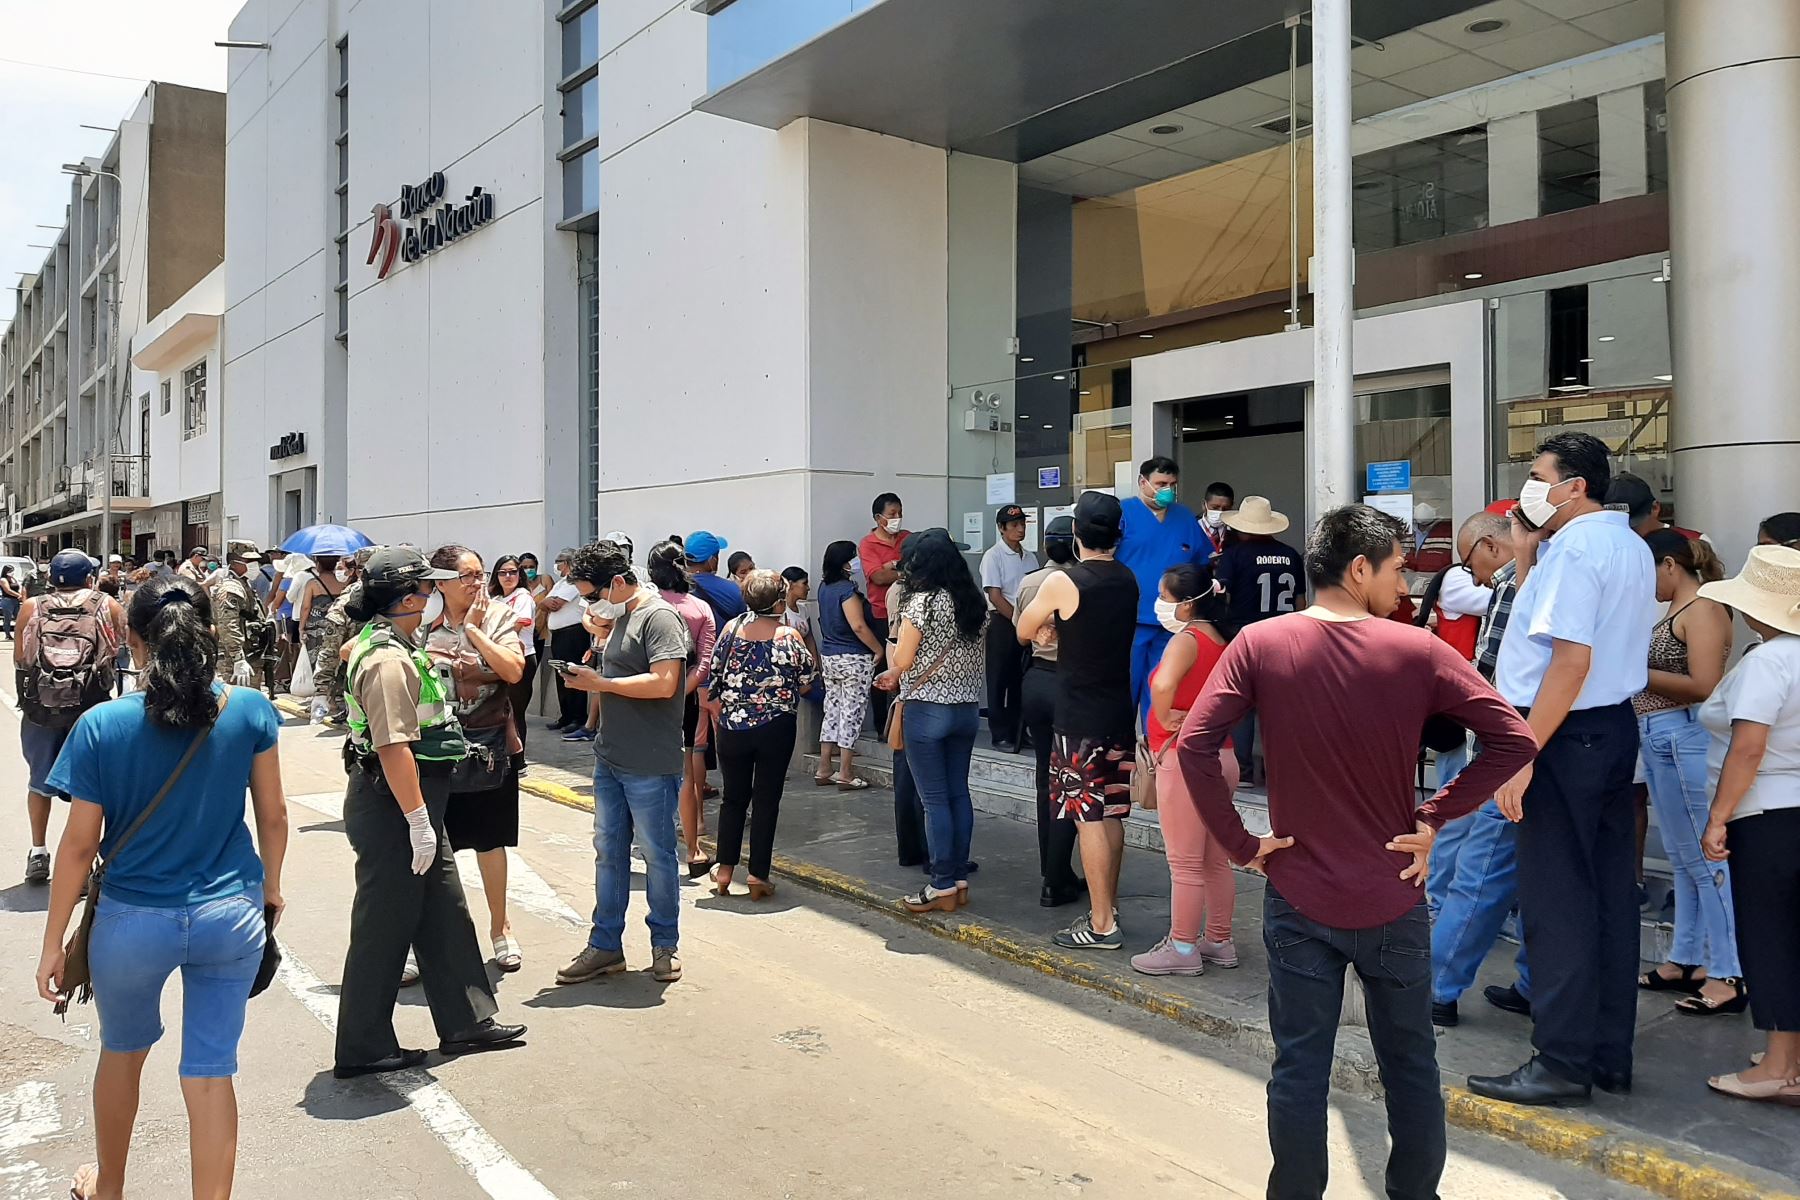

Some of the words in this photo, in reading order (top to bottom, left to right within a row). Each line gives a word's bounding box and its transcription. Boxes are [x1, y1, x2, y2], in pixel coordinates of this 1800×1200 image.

[401, 172, 445, 219] Banco
[402, 227, 419, 262] de
[420, 217, 436, 254] la
[435, 186, 496, 246] Nación
[1256, 555, 1291, 565] ROBERTO
[1256, 572, 1296, 612] 12
